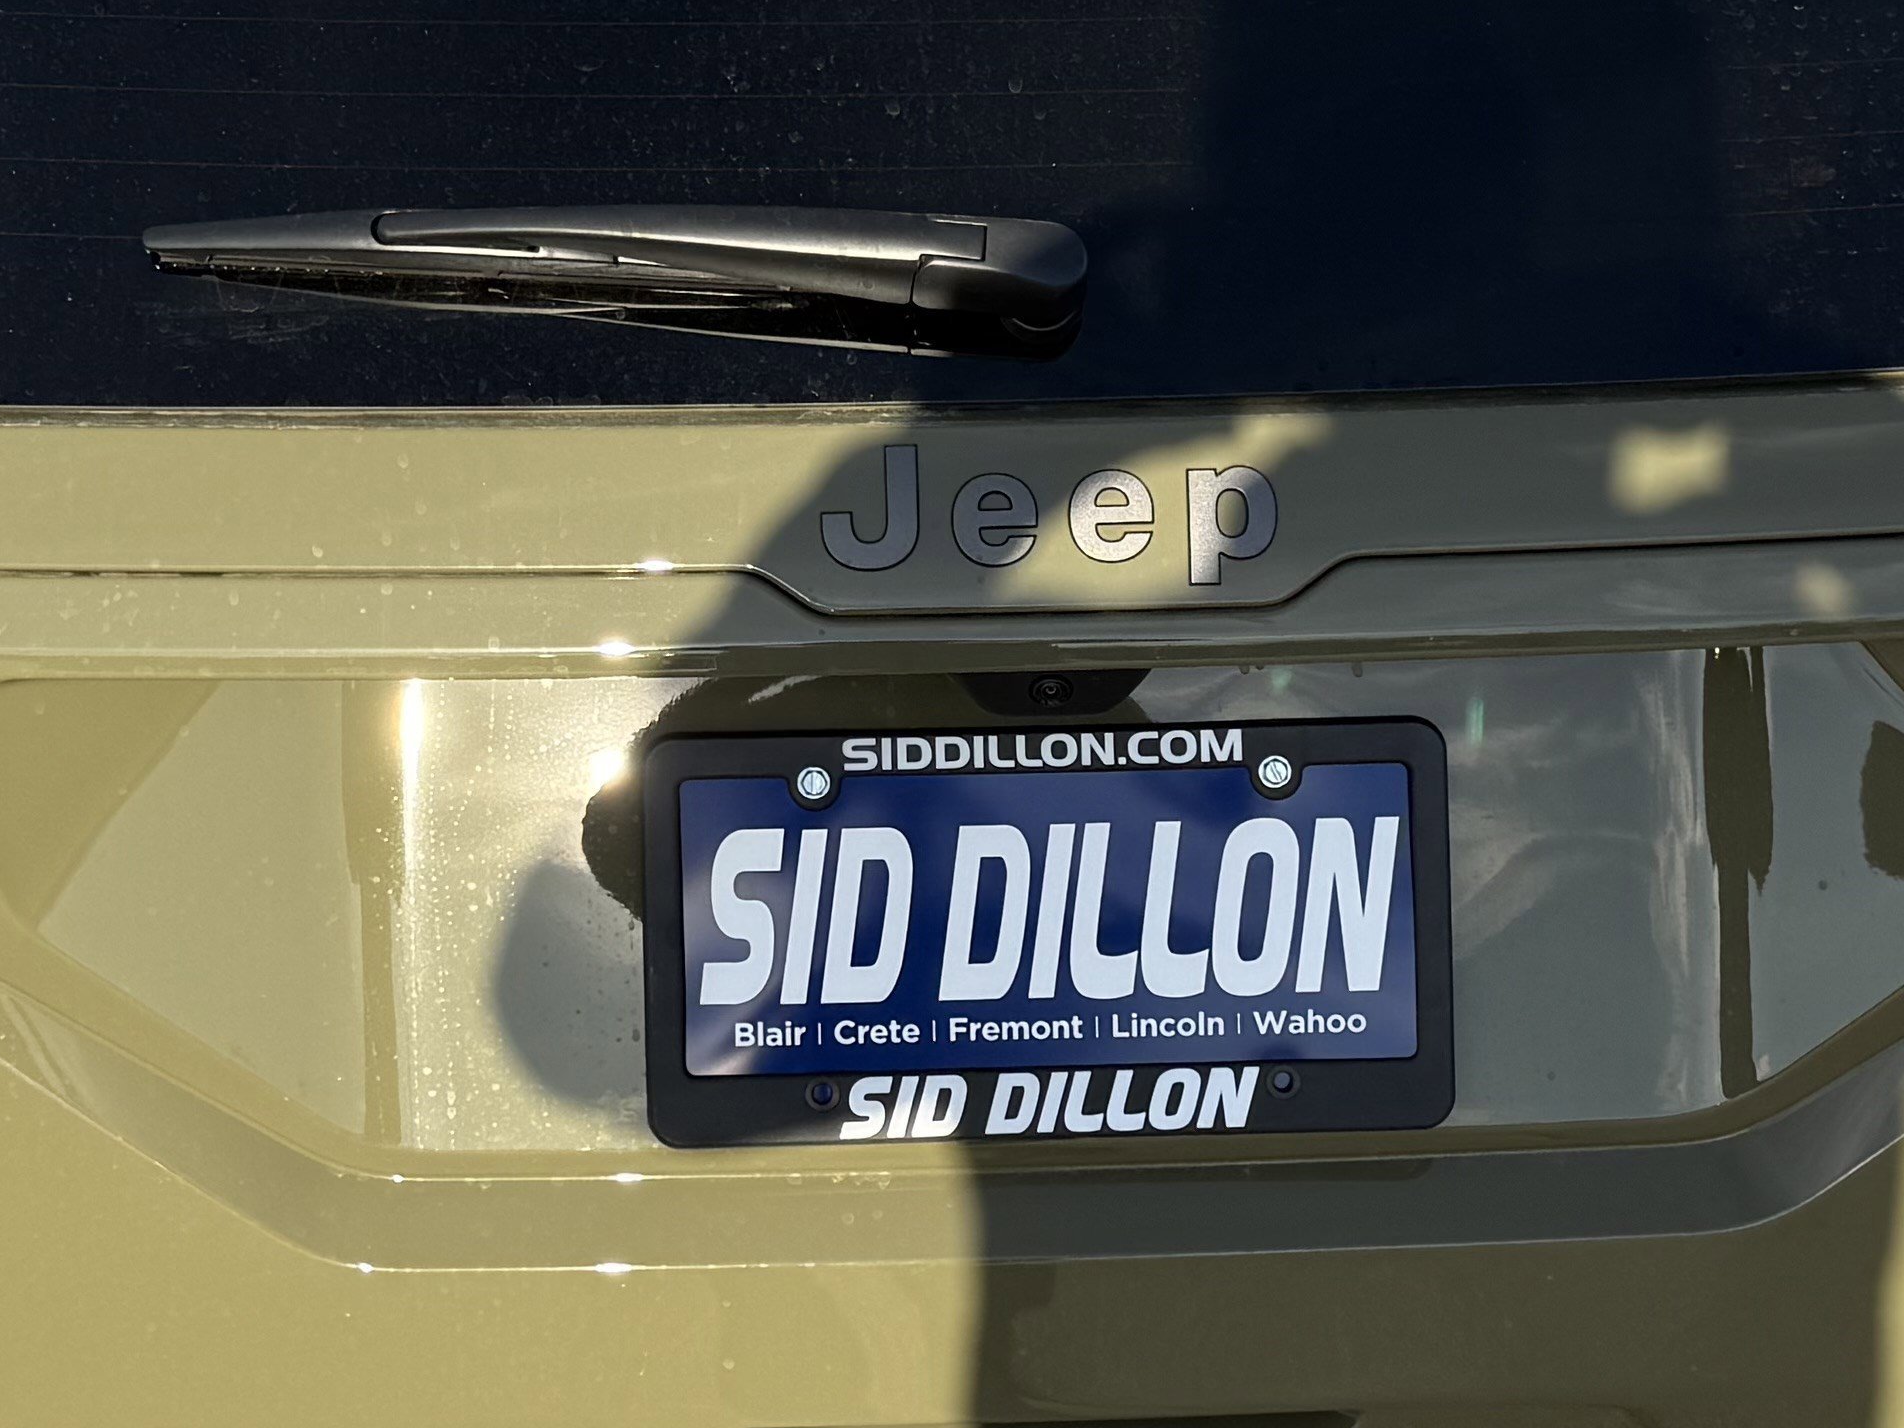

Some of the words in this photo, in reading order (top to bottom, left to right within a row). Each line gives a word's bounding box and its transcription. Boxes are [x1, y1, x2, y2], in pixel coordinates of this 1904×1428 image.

[820, 444, 1279, 585] Jeep
[841, 728, 1244, 772] SIDDILLON.COM
[699, 827, 914, 1007] SID
[938, 816, 1401, 1003] DILLON
[733, 1021, 808, 1048] Blair
[833, 1018, 921, 1046] Crete
[948, 1014, 1085, 1043] Fremont
[1111, 1010, 1226, 1039] Lincoln
[1252, 1007, 1368, 1036] Wahoo
[839, 1074, 968, 1140] SID
[984, 1065, 1261, 1137] DILLON
